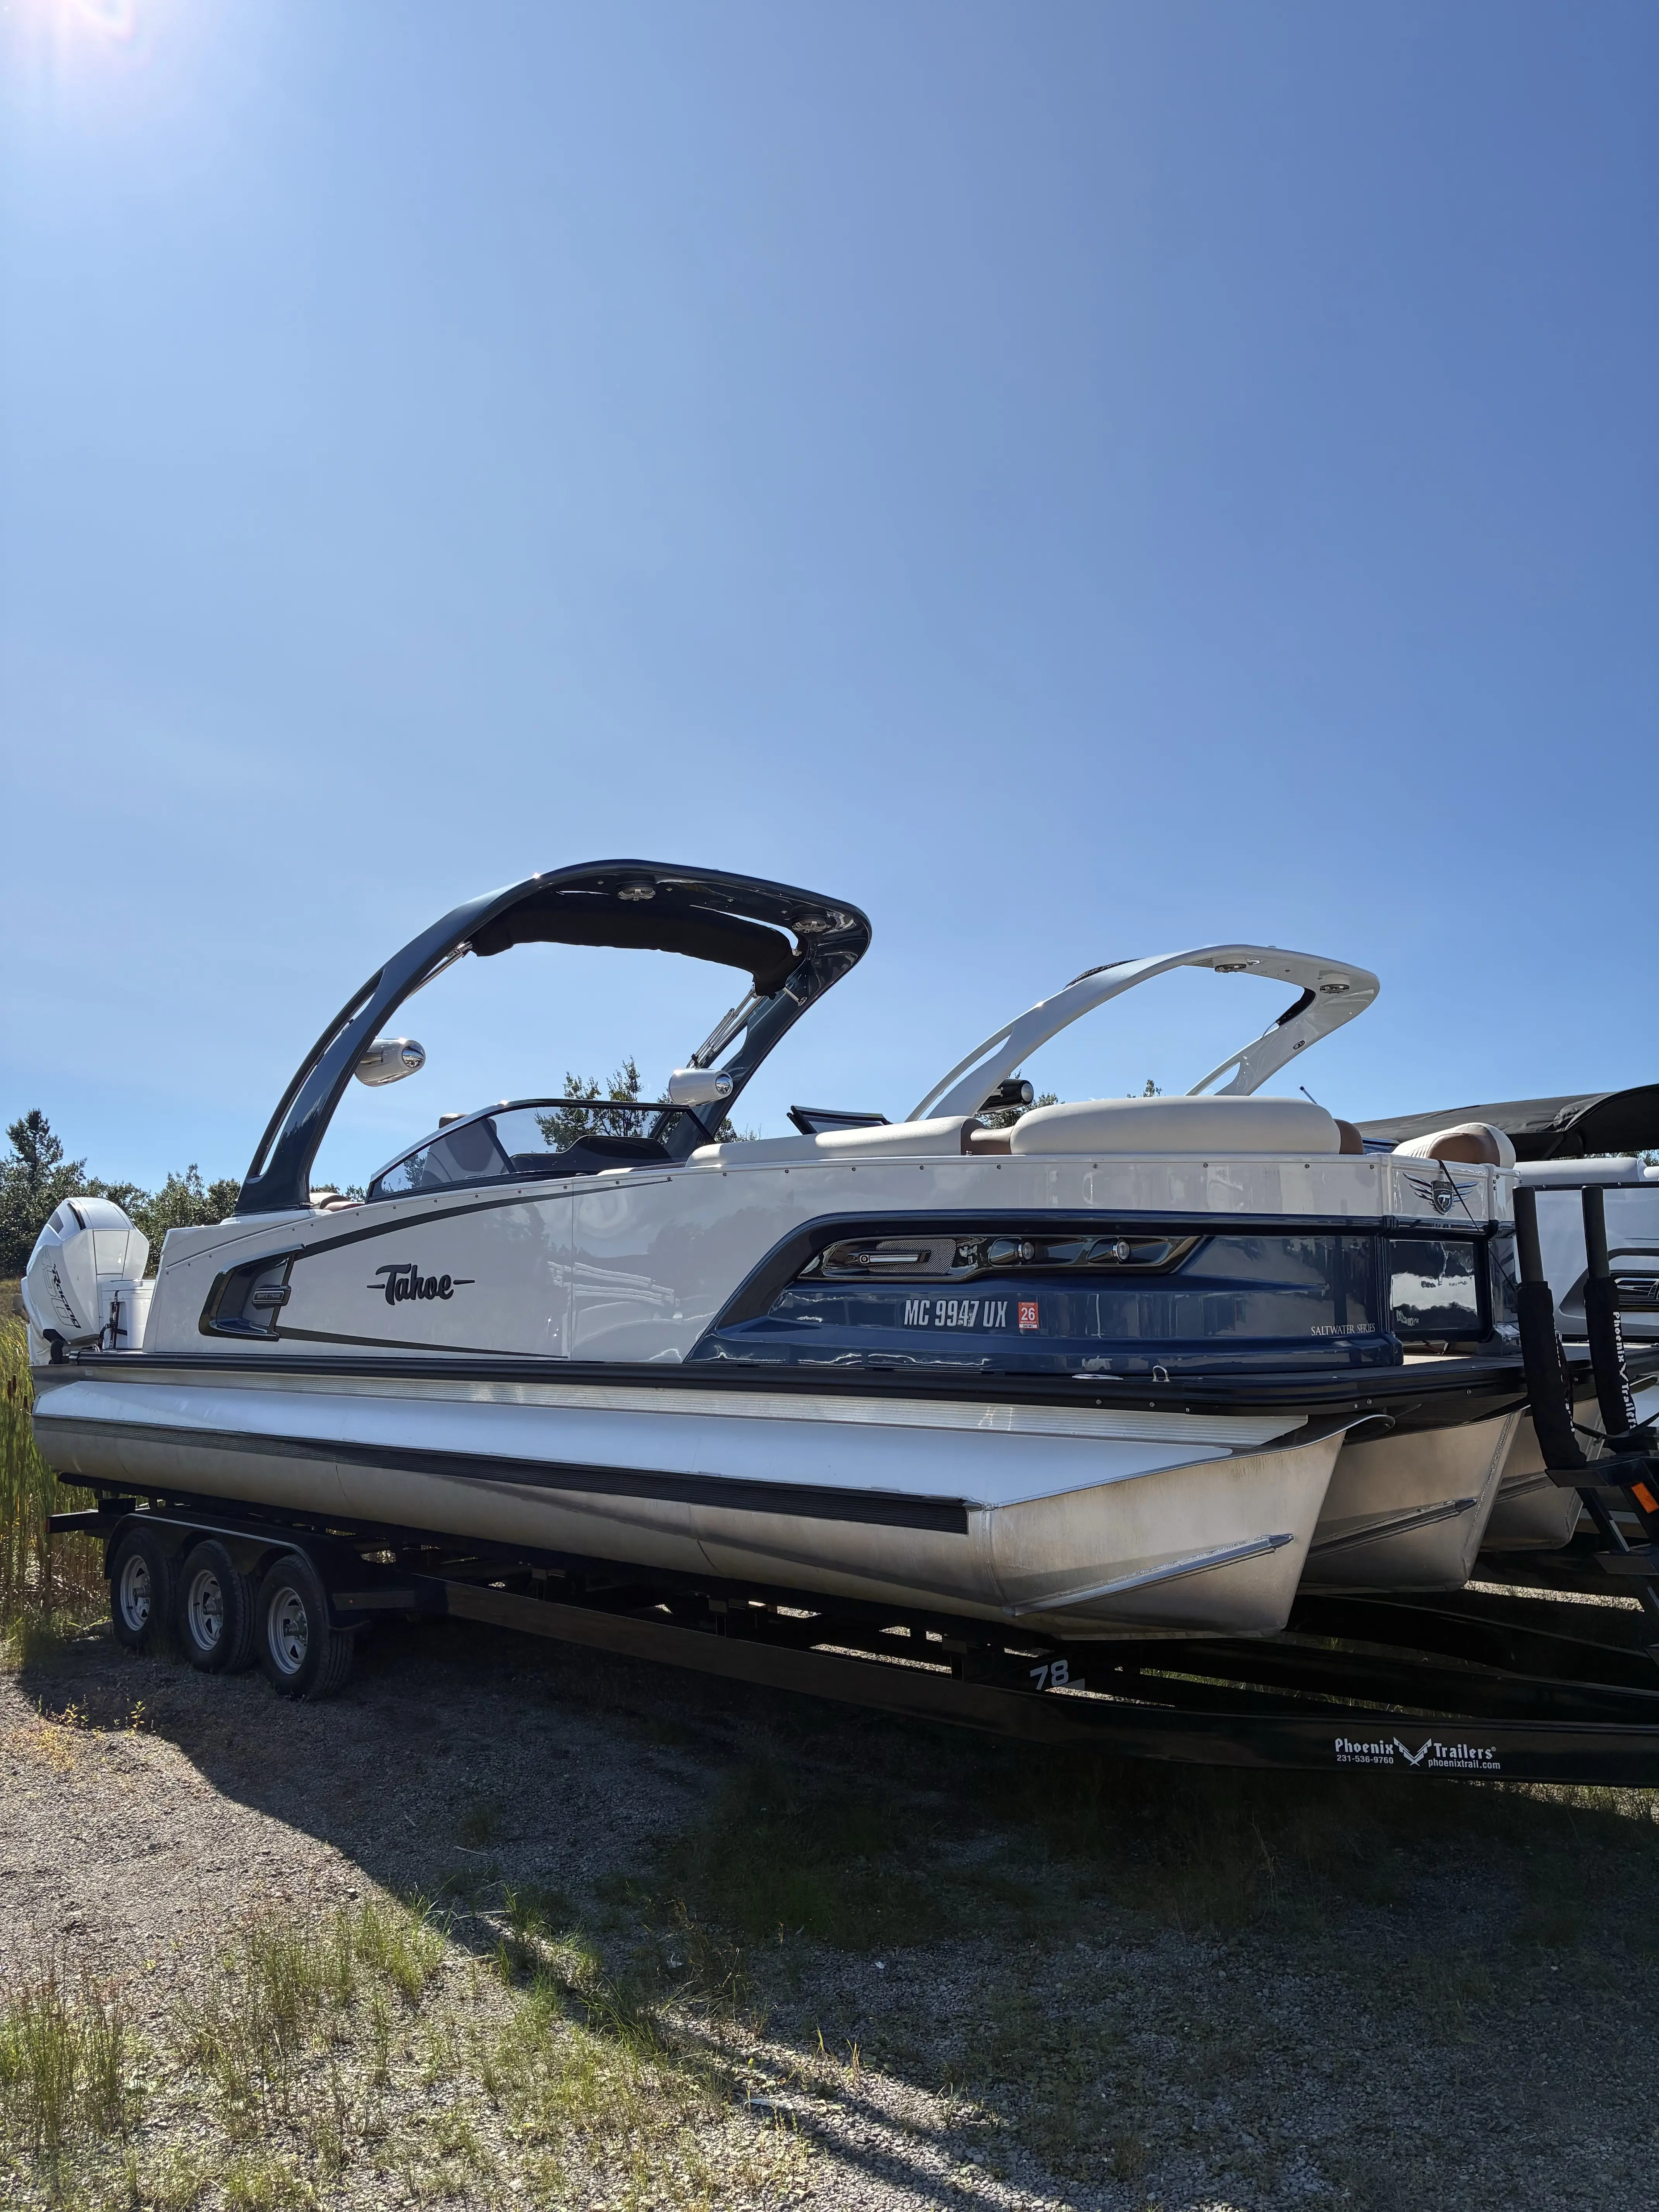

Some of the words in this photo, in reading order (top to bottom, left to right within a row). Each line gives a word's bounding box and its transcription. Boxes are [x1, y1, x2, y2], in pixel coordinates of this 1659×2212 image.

[375, 1263, 454, 1305] Tahoe
[903, 1299, 930, 1326] MC
[934, 1300, 980, 1328] 9947
[983, 1301, 1008, 1328] UX
[1021, 1307, 1035, 1321] 26
[1311, 1324, 1355, 1336] SALTWATER
[1357, 1323, 1375, 1333] SERIES
[1613, 1312, 1625, 1362] Phoenix
[1030, 1659, 1069, 1690] 78
[1335, 1738, 1394, 1755] Phoenix
[1336, 1754, 1394, 1764] 231-536-9760
[1428, 1758, 1501, 1769] phoenixtrail.com
